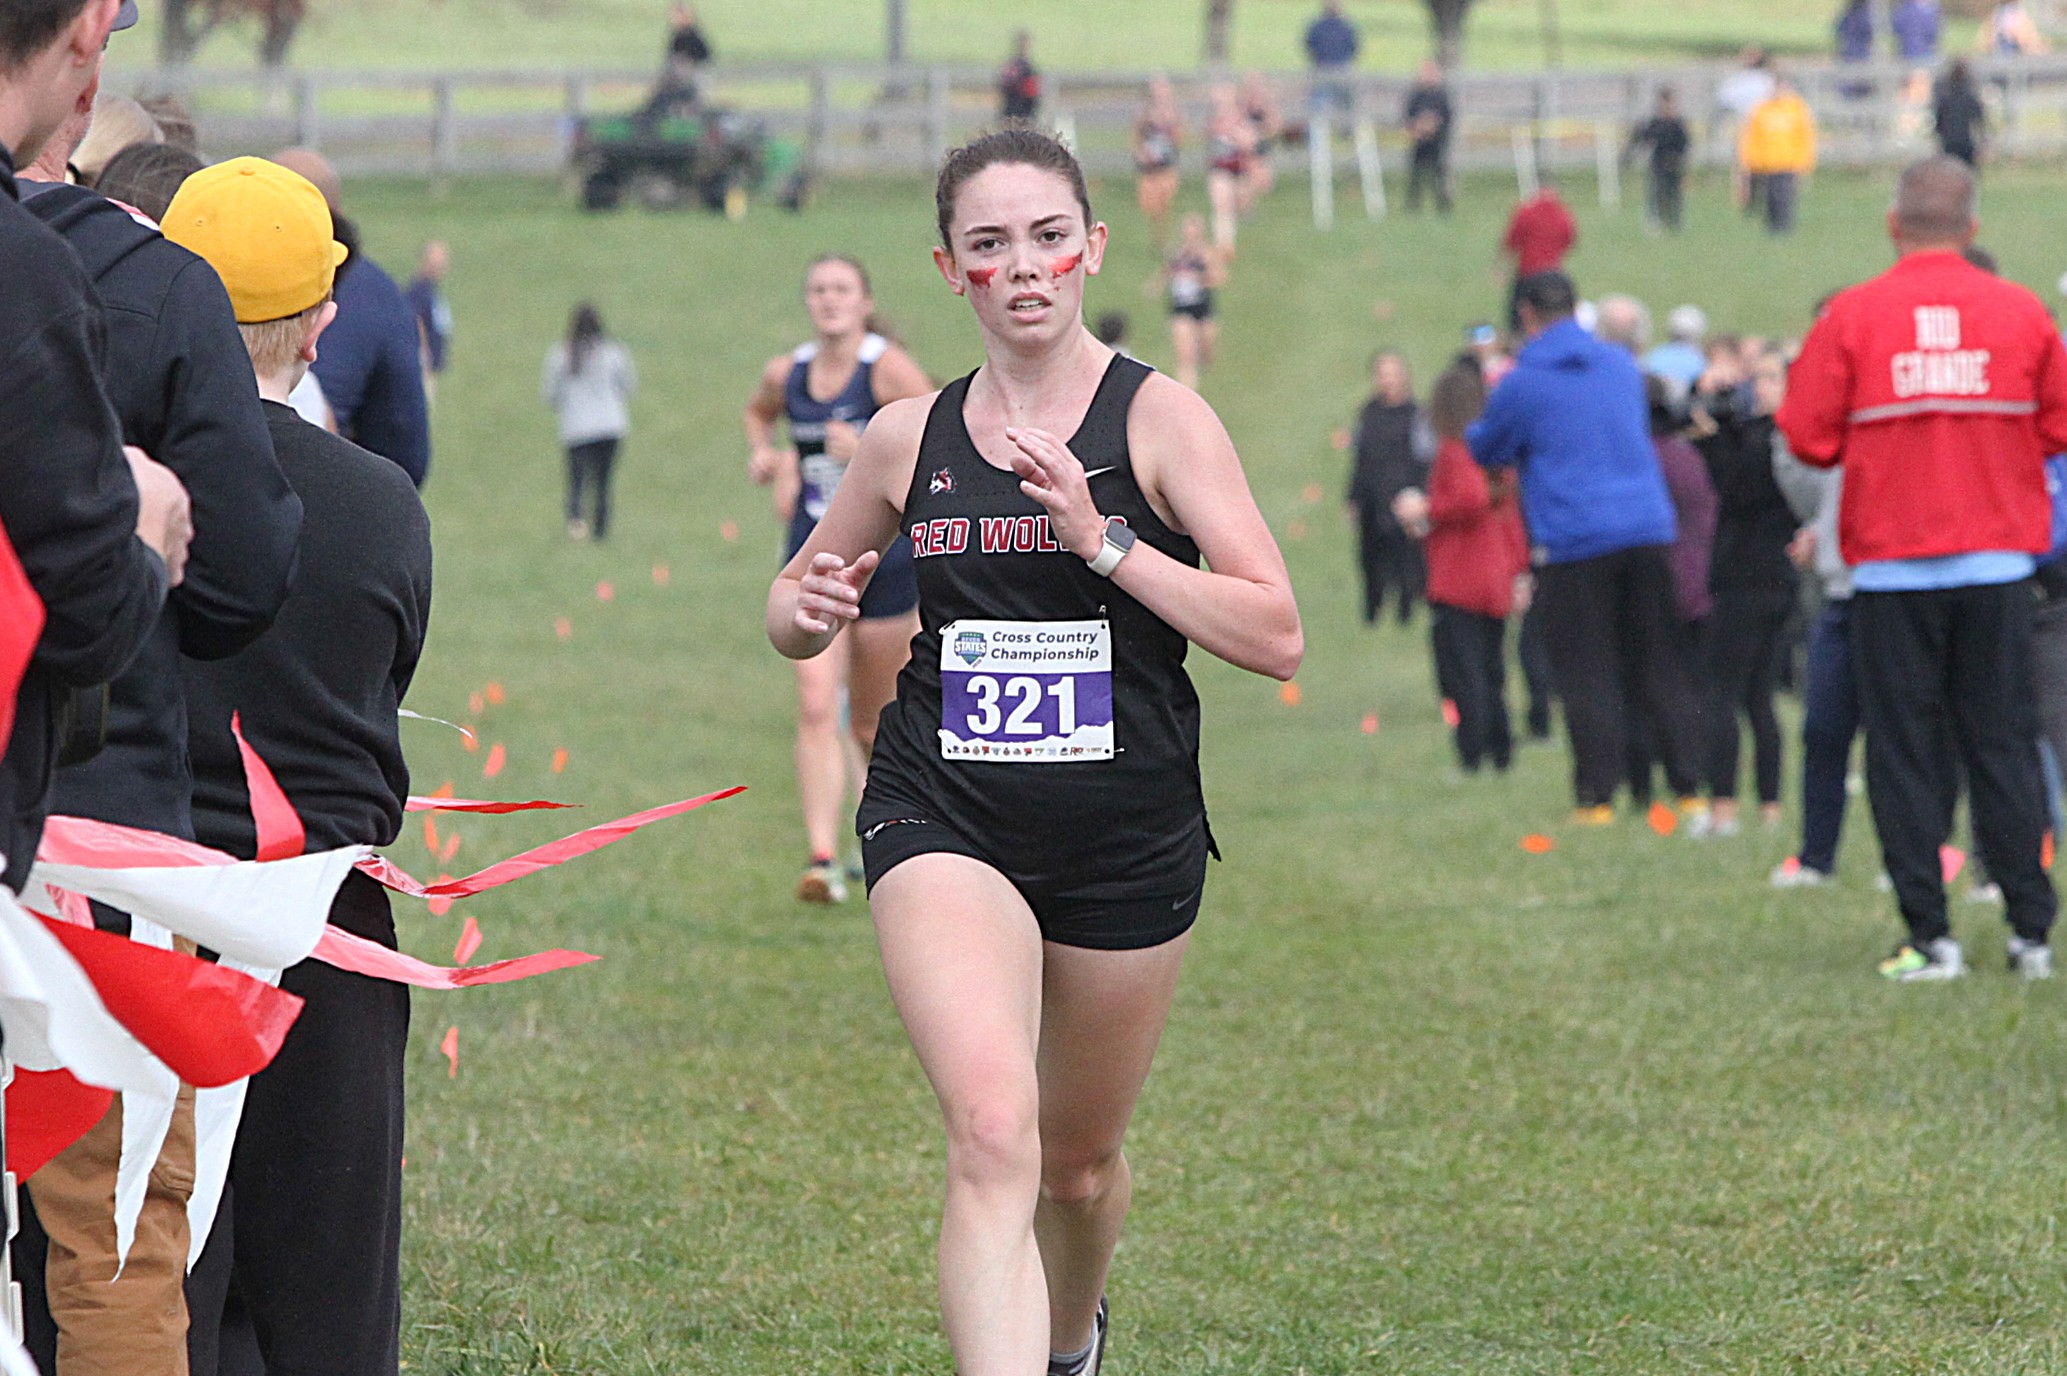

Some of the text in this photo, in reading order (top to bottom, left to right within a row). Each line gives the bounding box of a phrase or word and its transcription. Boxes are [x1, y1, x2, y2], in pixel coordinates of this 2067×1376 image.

[1890, 349, 1991, 398] GRANDE
[911, 514, 1128, 558] RED WOL
[954, 640, 987, 653] STATES
[992, 631, 1098, 644] Cross Country
[991, 647, 1099, 662] Championship
[966, 675, 1076, 735] 321
